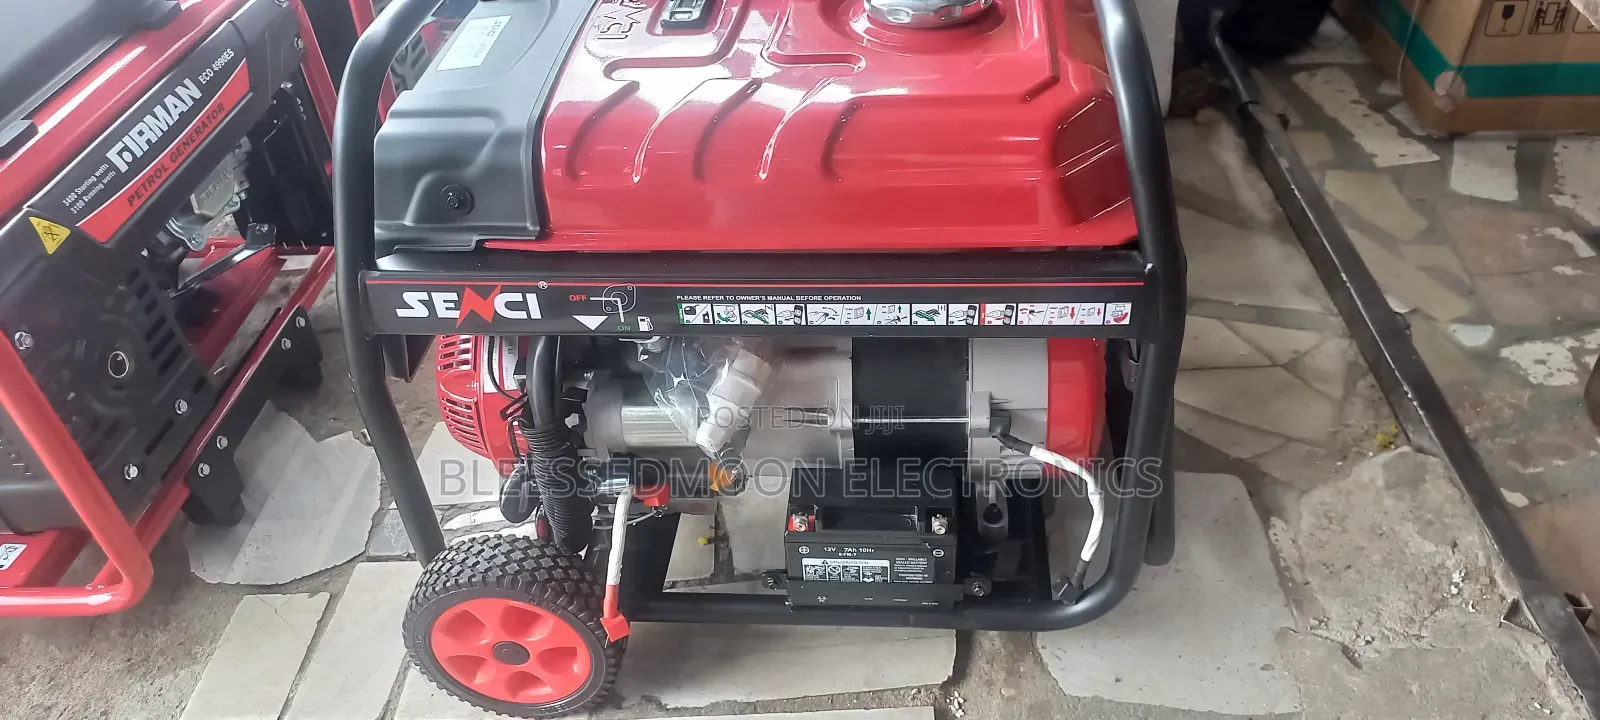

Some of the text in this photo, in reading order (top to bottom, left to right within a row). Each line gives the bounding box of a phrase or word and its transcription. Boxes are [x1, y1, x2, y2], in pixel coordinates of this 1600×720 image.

[105, 48, 235, 174] FIRMAN ECO 4990ES
[126, 163, 170, 207] PETROL
[169, 102, 226, 163] GENERATOR
[62, 163, 110, 207] 3400 Starting watts
[70, 170, 117, 214] 3100 Running watts
[396, 285, 543, 328] SENCI
